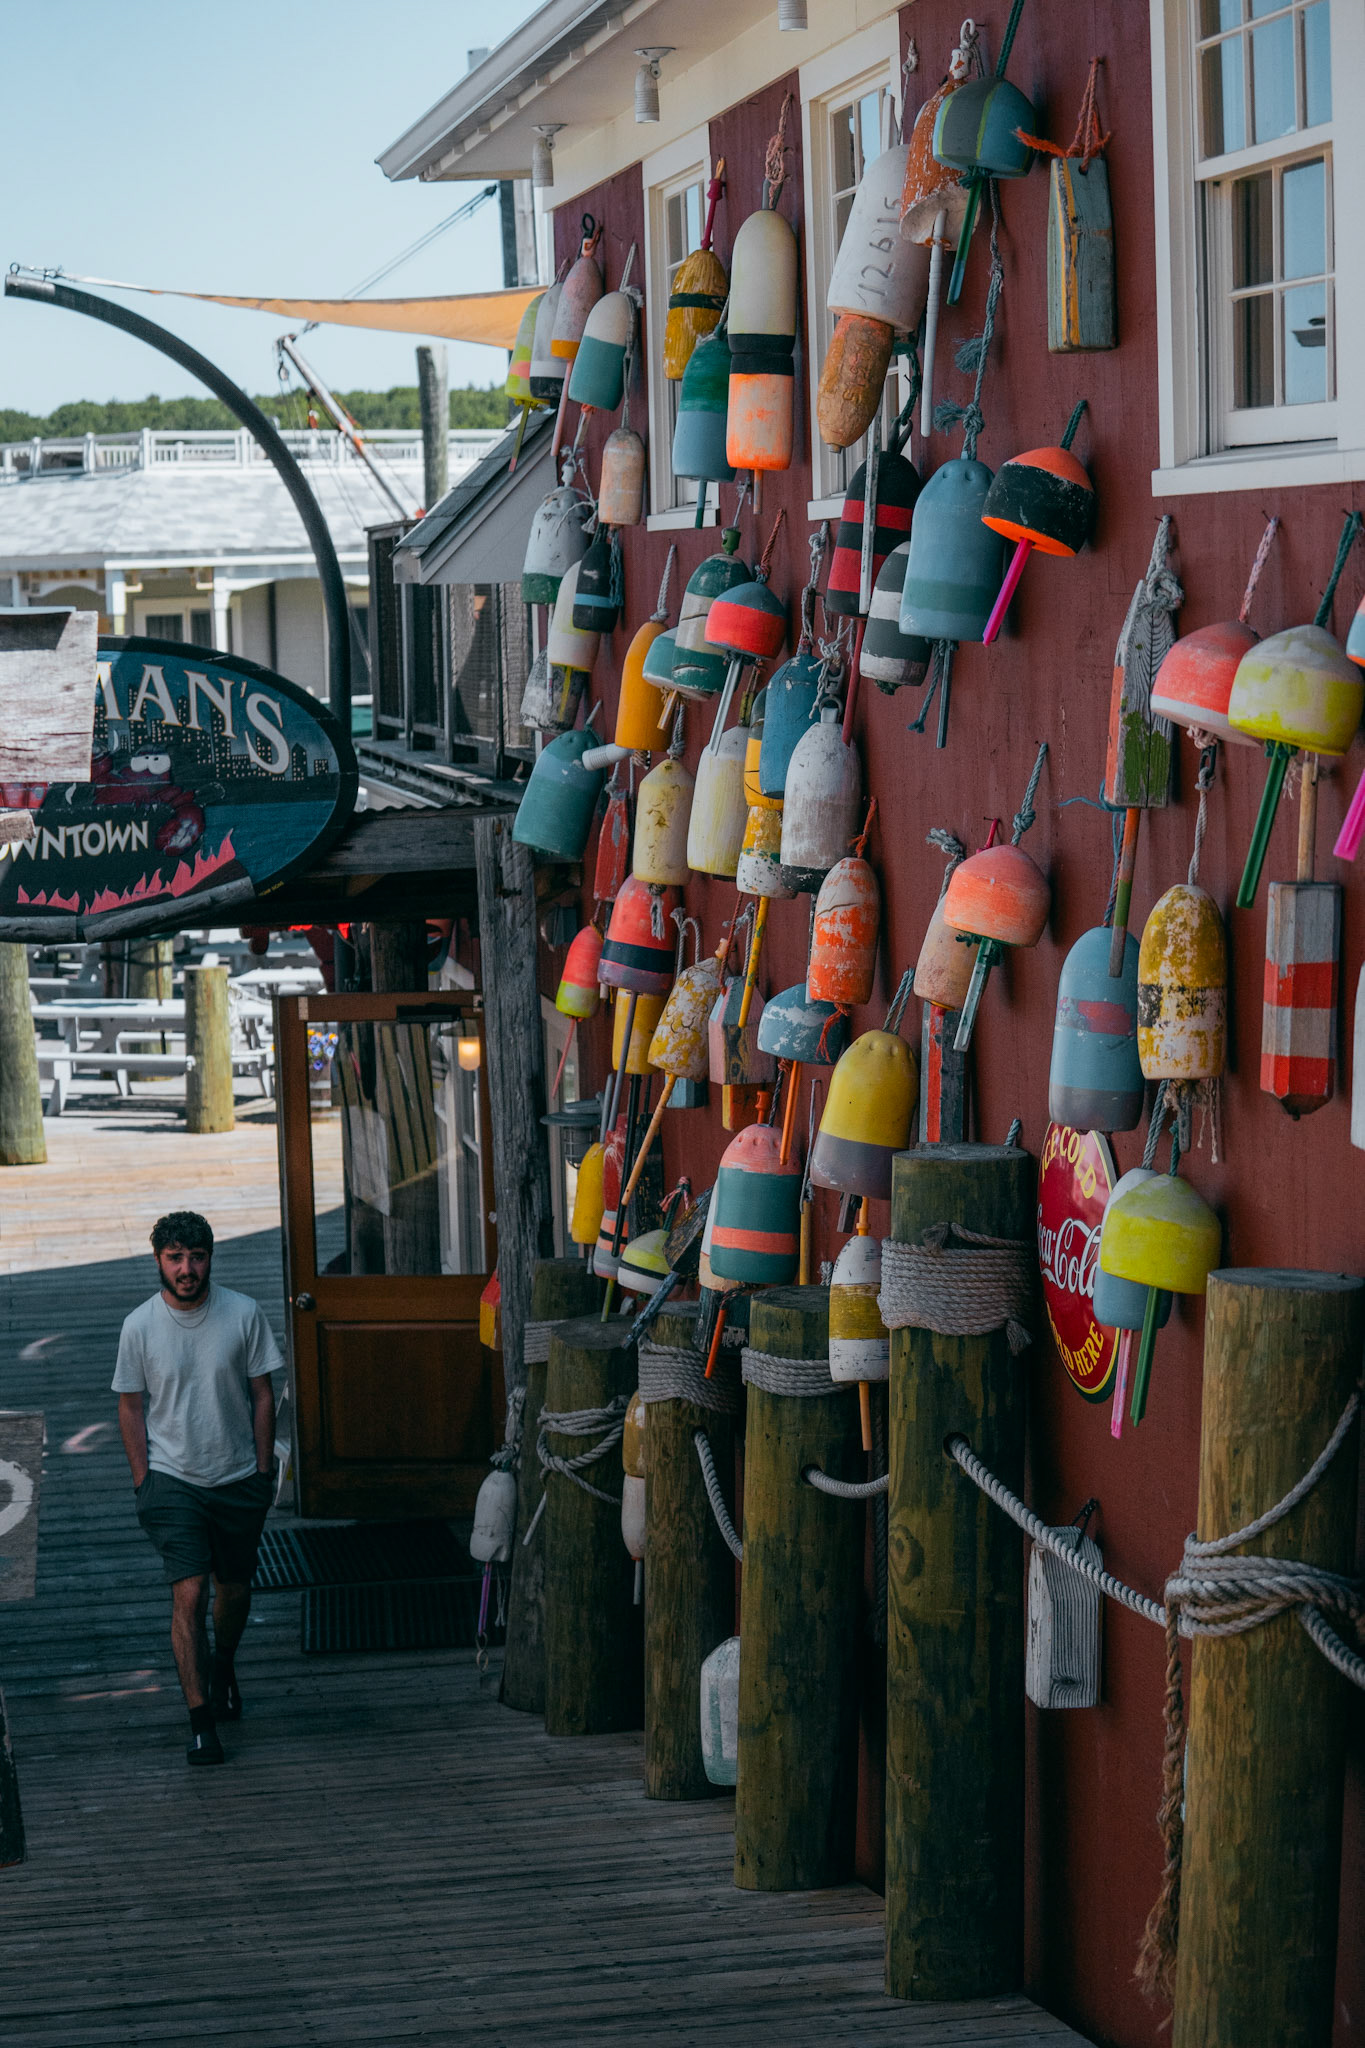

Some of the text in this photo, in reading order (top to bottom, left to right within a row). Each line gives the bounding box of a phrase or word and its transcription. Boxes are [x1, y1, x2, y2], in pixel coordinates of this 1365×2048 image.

[1041, 1126, 1096, 1199] ICE COLD
[1073, 1321, 1104, 1376] HERE
